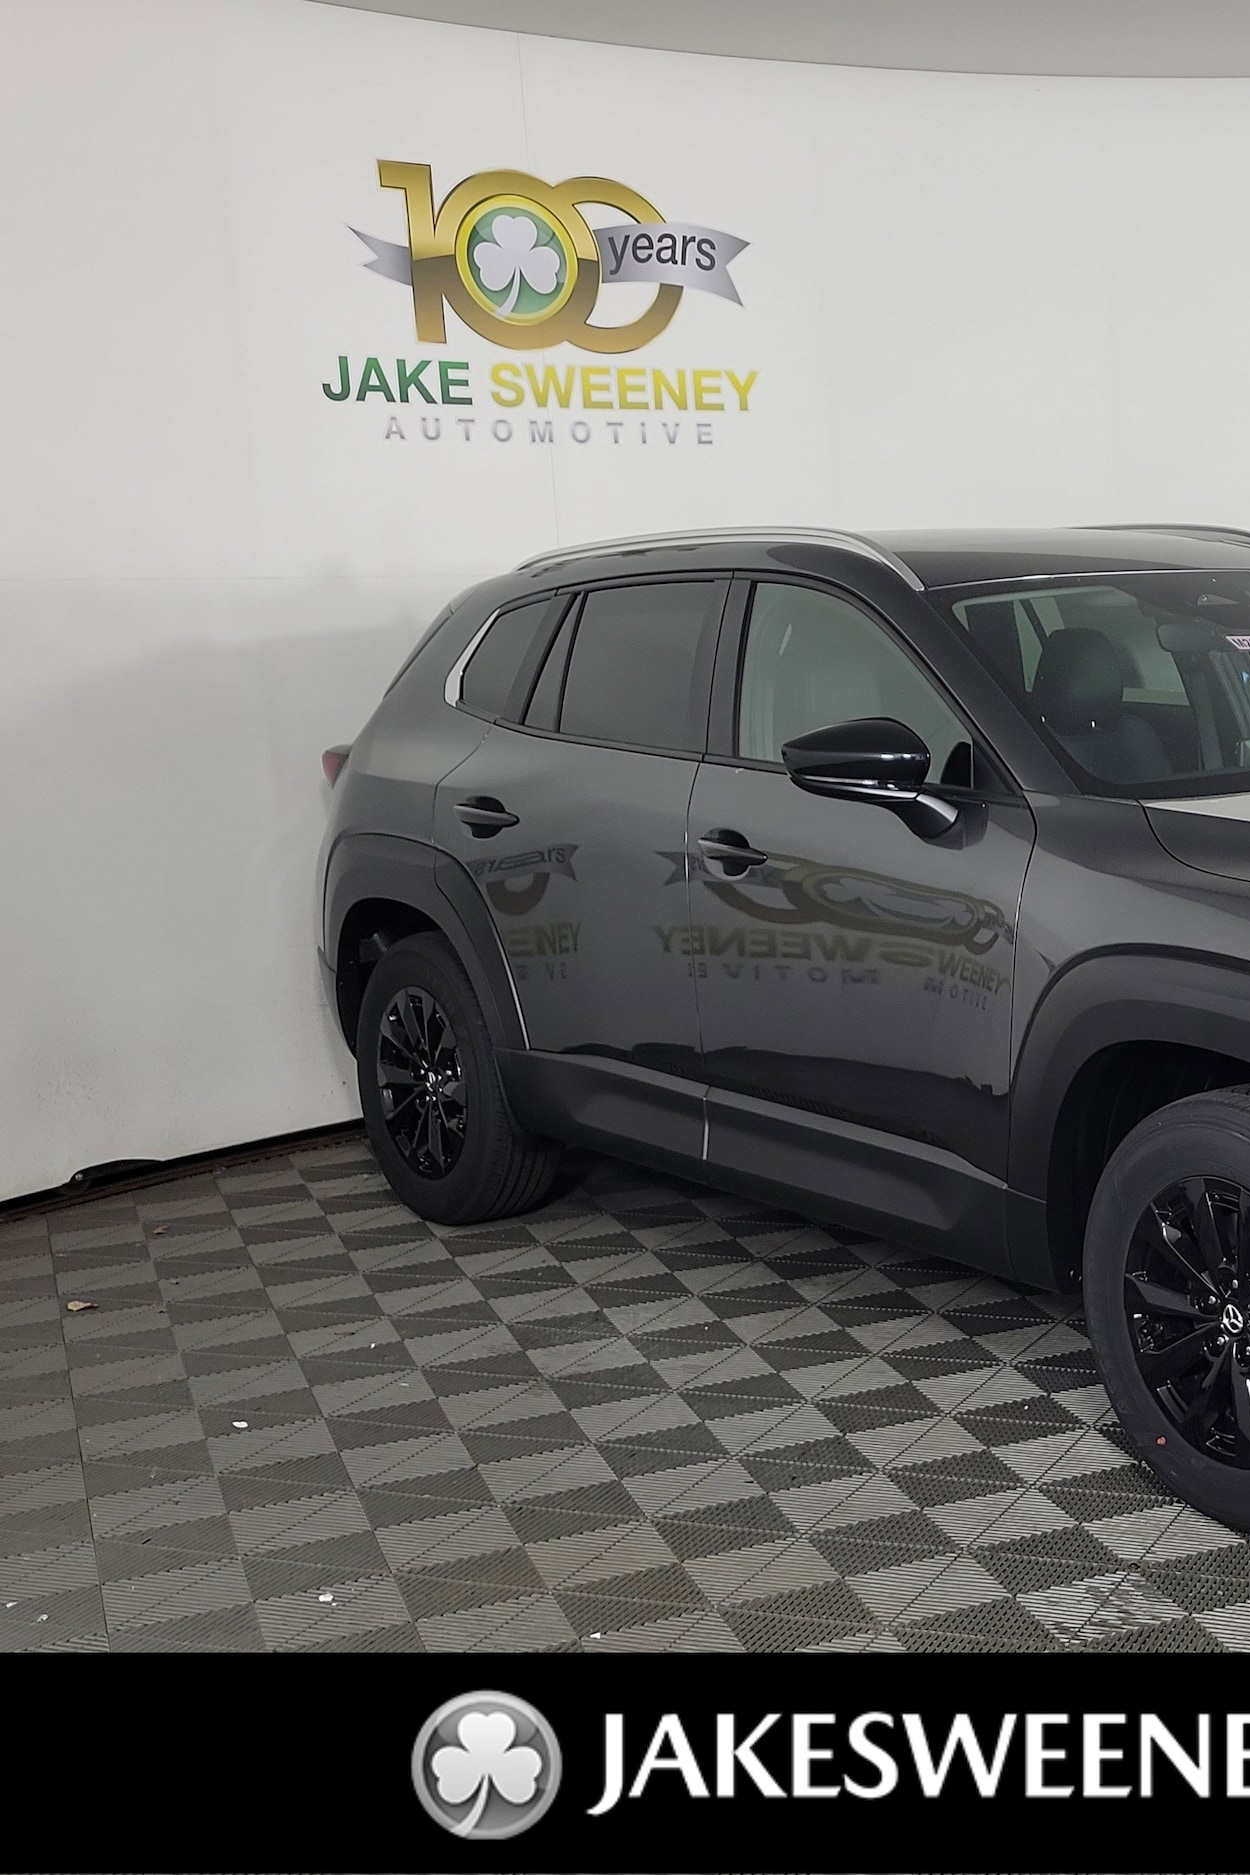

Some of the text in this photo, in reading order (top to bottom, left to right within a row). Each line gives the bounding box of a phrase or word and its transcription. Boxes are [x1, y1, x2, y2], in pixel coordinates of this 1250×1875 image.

[376, 158, 685, 354] 100
[608, 232, 717, 275] years
[322, 355, 759, 411] JAKE SWEENEY
[385, 416, 714, 444] AUTOMOTIVE
